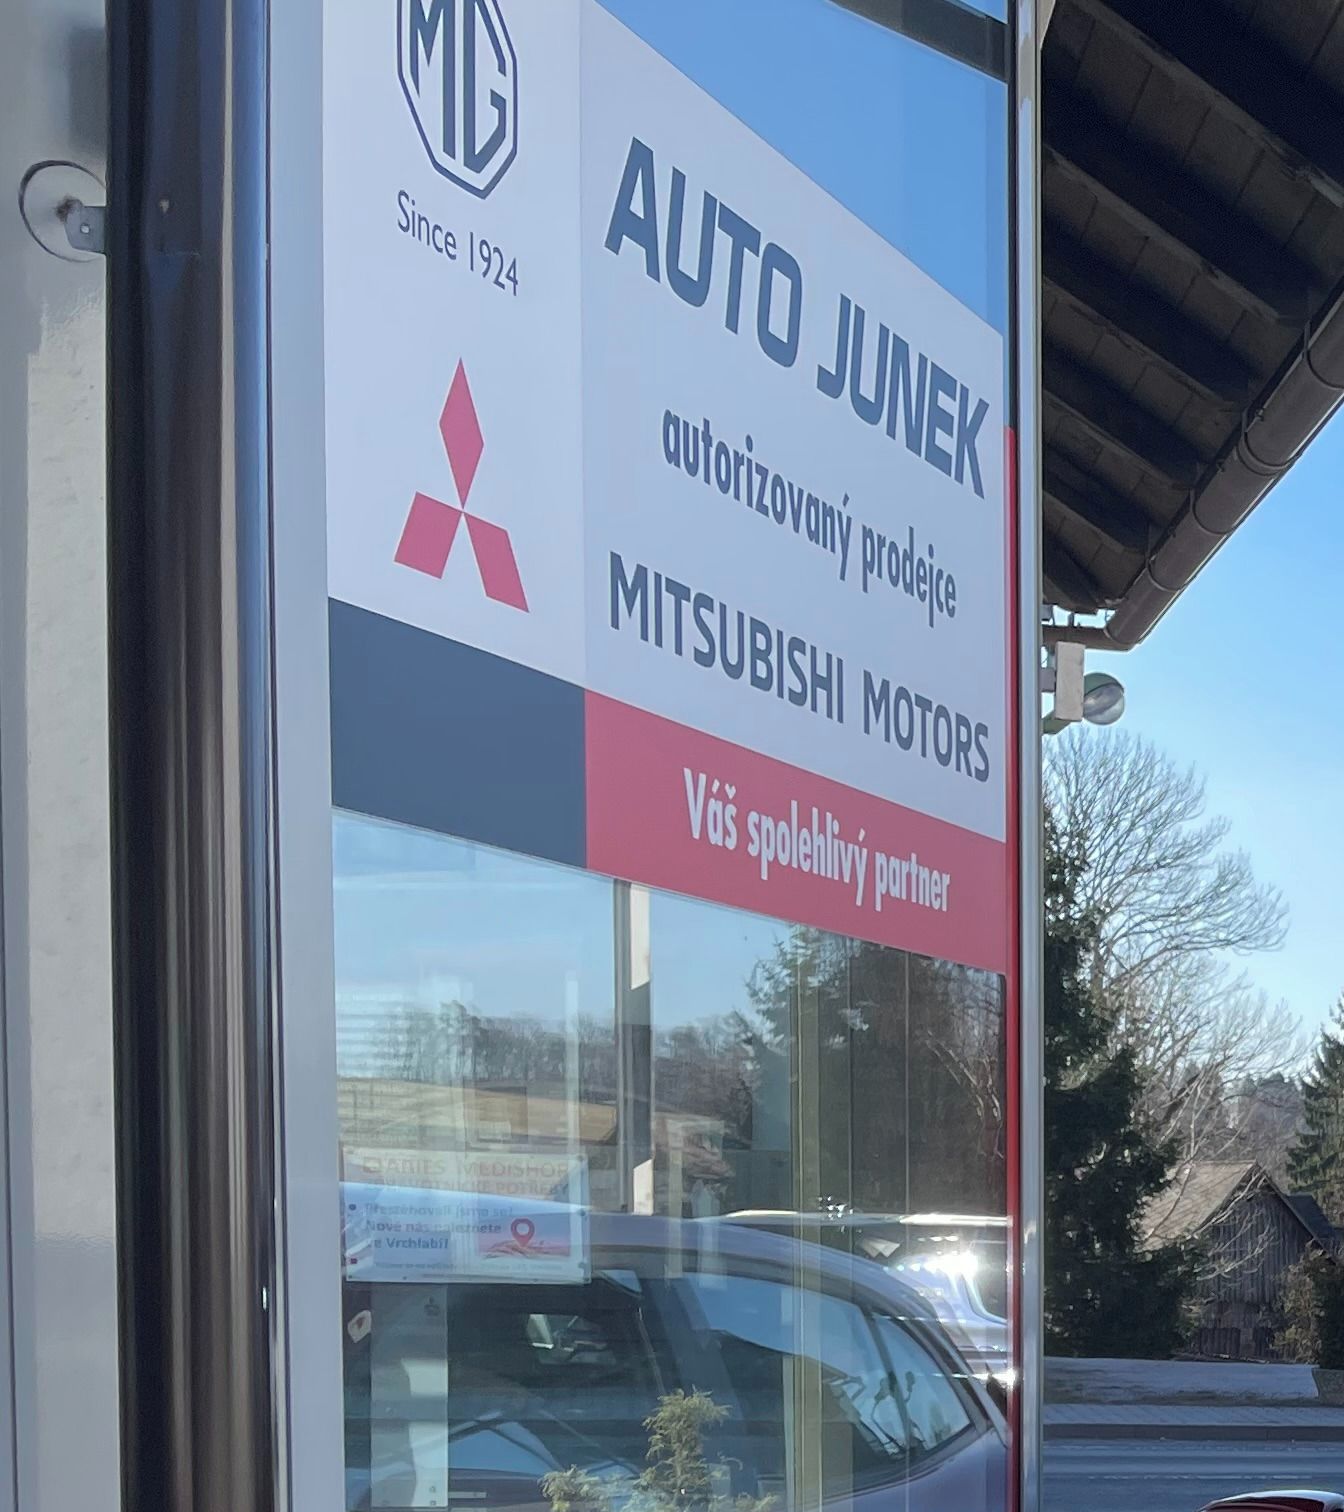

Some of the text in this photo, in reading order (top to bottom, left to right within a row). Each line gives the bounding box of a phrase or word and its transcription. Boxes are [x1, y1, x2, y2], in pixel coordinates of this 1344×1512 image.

[409, 0, 507, 174] MG
[397, 190, 519, 296] Since 1924
[604, 136, 990, 500] AUTO JUNEK
[662, 409, 956, 627] autorizovaný prodejce
[610, 551, 989, 782] MITSUBISHI MOTORS
[683, 767, 951, 912] Váš spolehlivý partner
